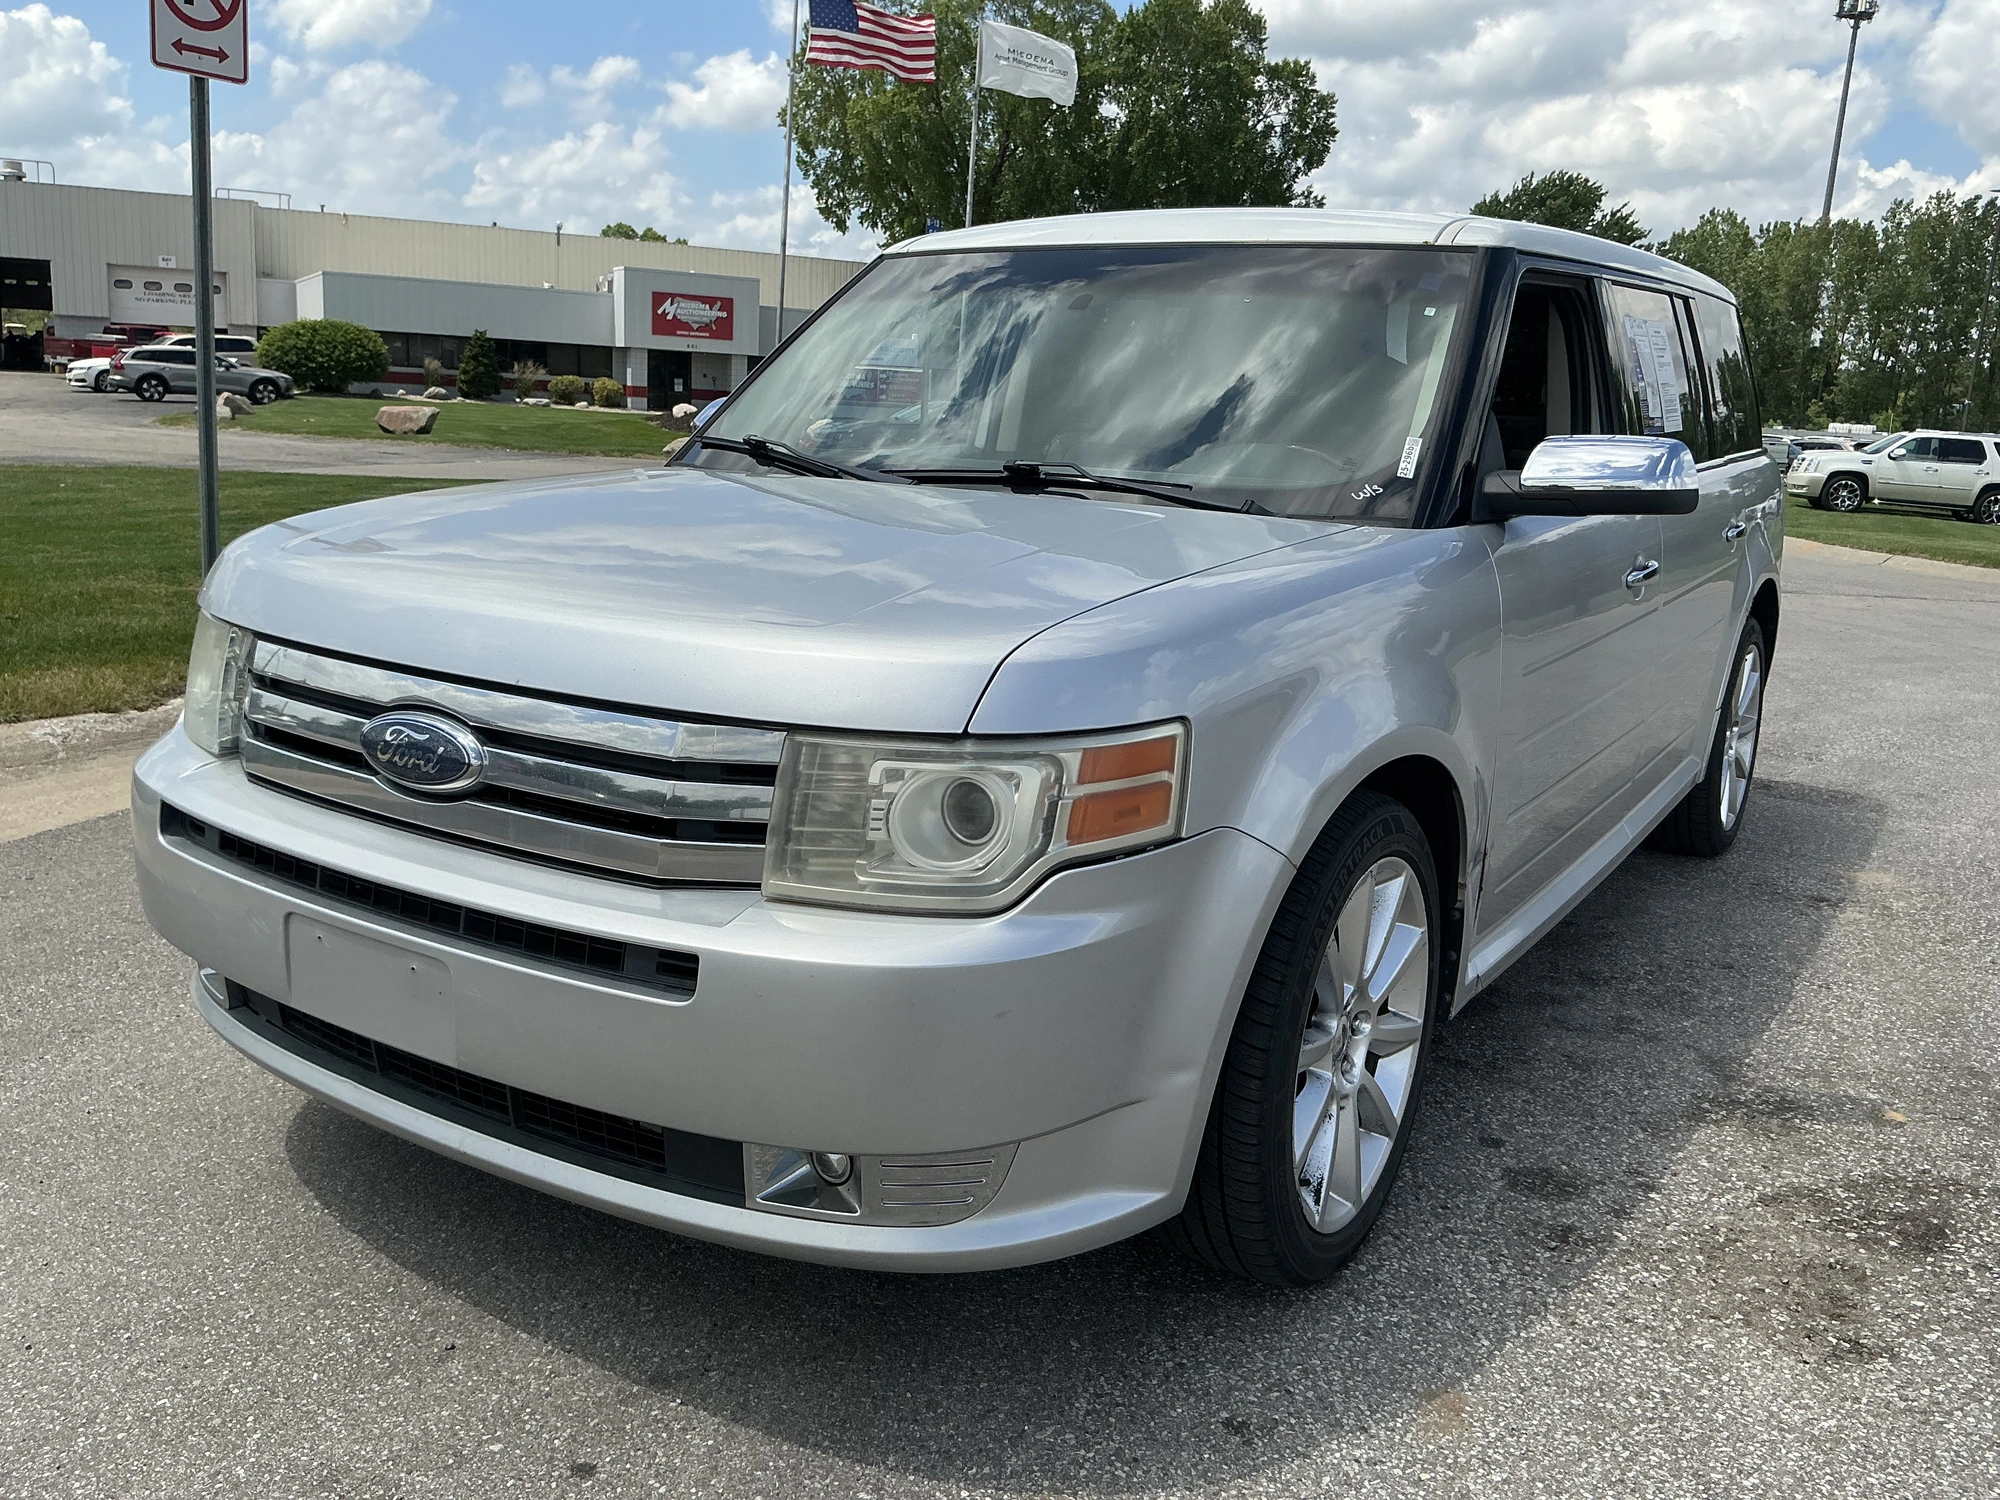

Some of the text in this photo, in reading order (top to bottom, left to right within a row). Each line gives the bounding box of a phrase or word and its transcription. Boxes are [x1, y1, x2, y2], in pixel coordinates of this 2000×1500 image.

[1012, 57, 1048, 72] Management
[1048, 66, 1069, 77] Group
[676, 308, 728, 318] AUCTIONEERING
[679, 302, 710, 310] MIEDEMA
[377, 725, 445, 774] Ford
[1302, 822, 1386, 972] MASTERTRACK
